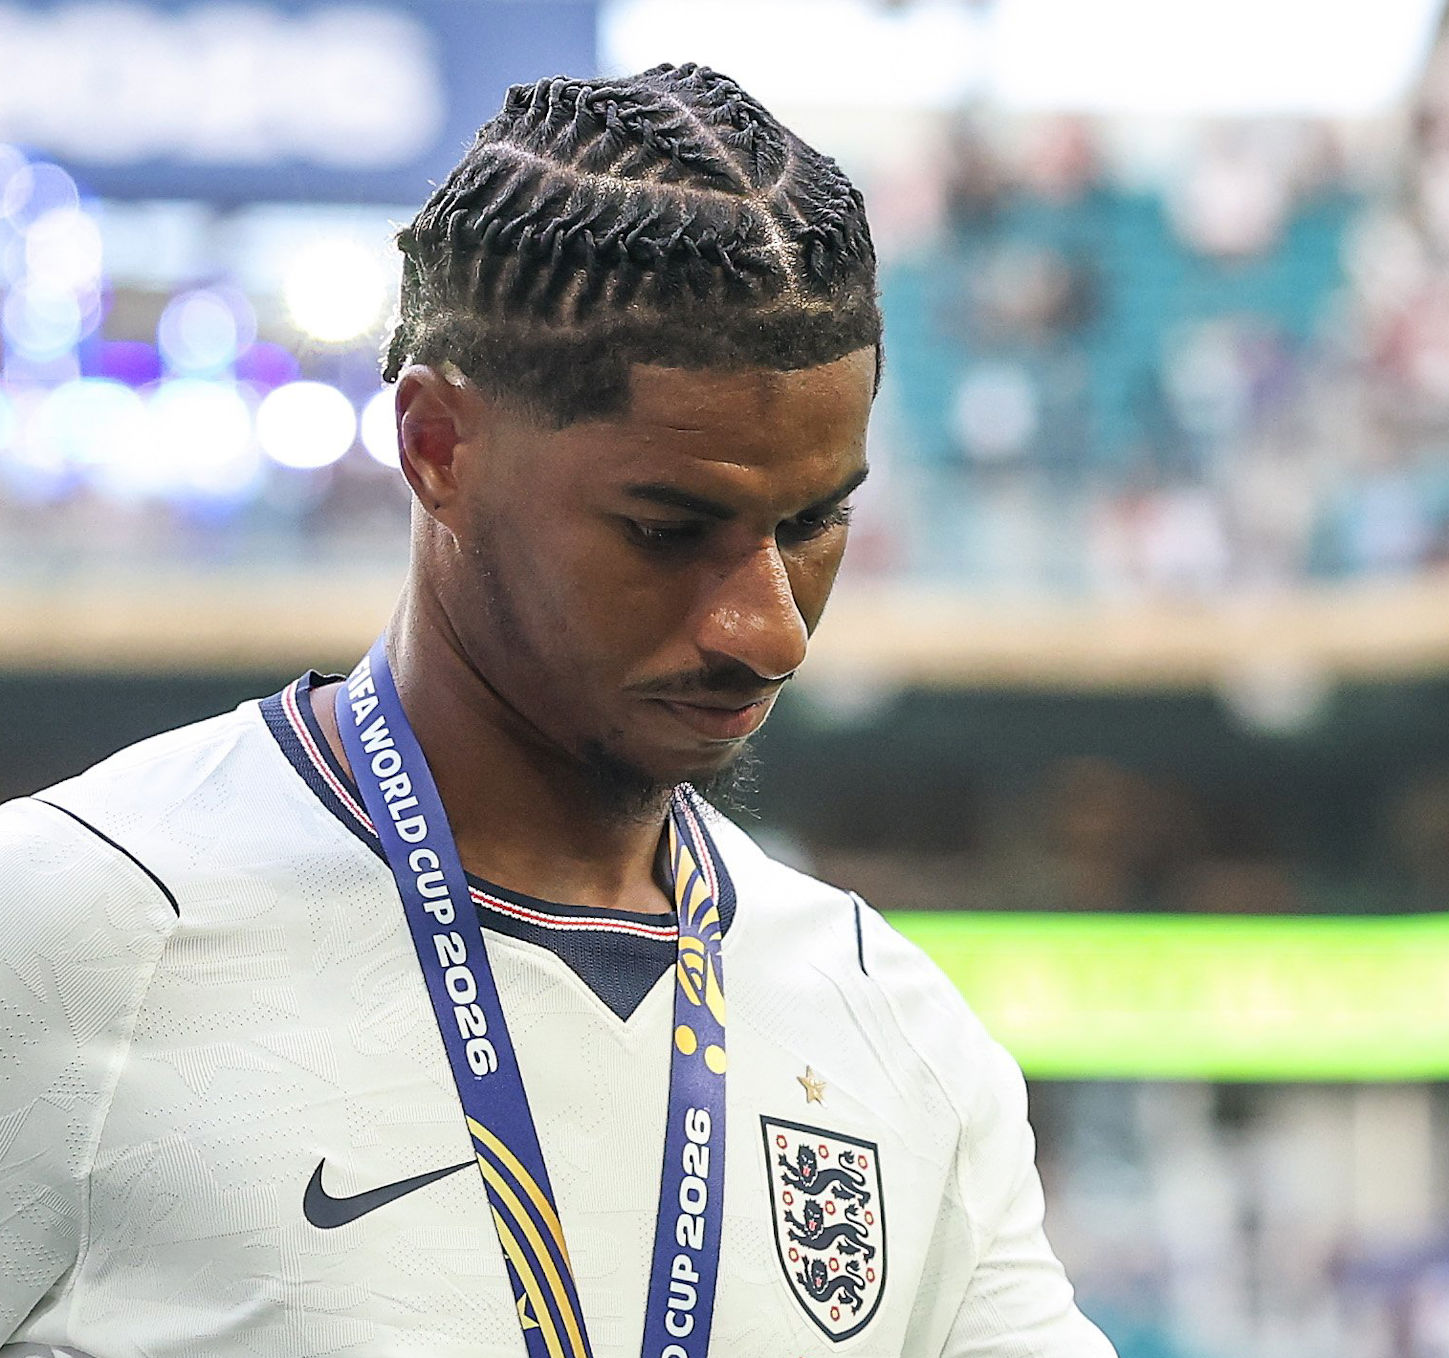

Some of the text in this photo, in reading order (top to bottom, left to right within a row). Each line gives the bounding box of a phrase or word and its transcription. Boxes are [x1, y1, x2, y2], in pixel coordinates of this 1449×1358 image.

[359, 714, 430, 844] WORLD
[408, 847, 457, 925] CUP
[432, 931, 500, 1077] 2026
[674, 1106, 713, 1251] 2026
[664, 1253, 700, 1339] CUP
